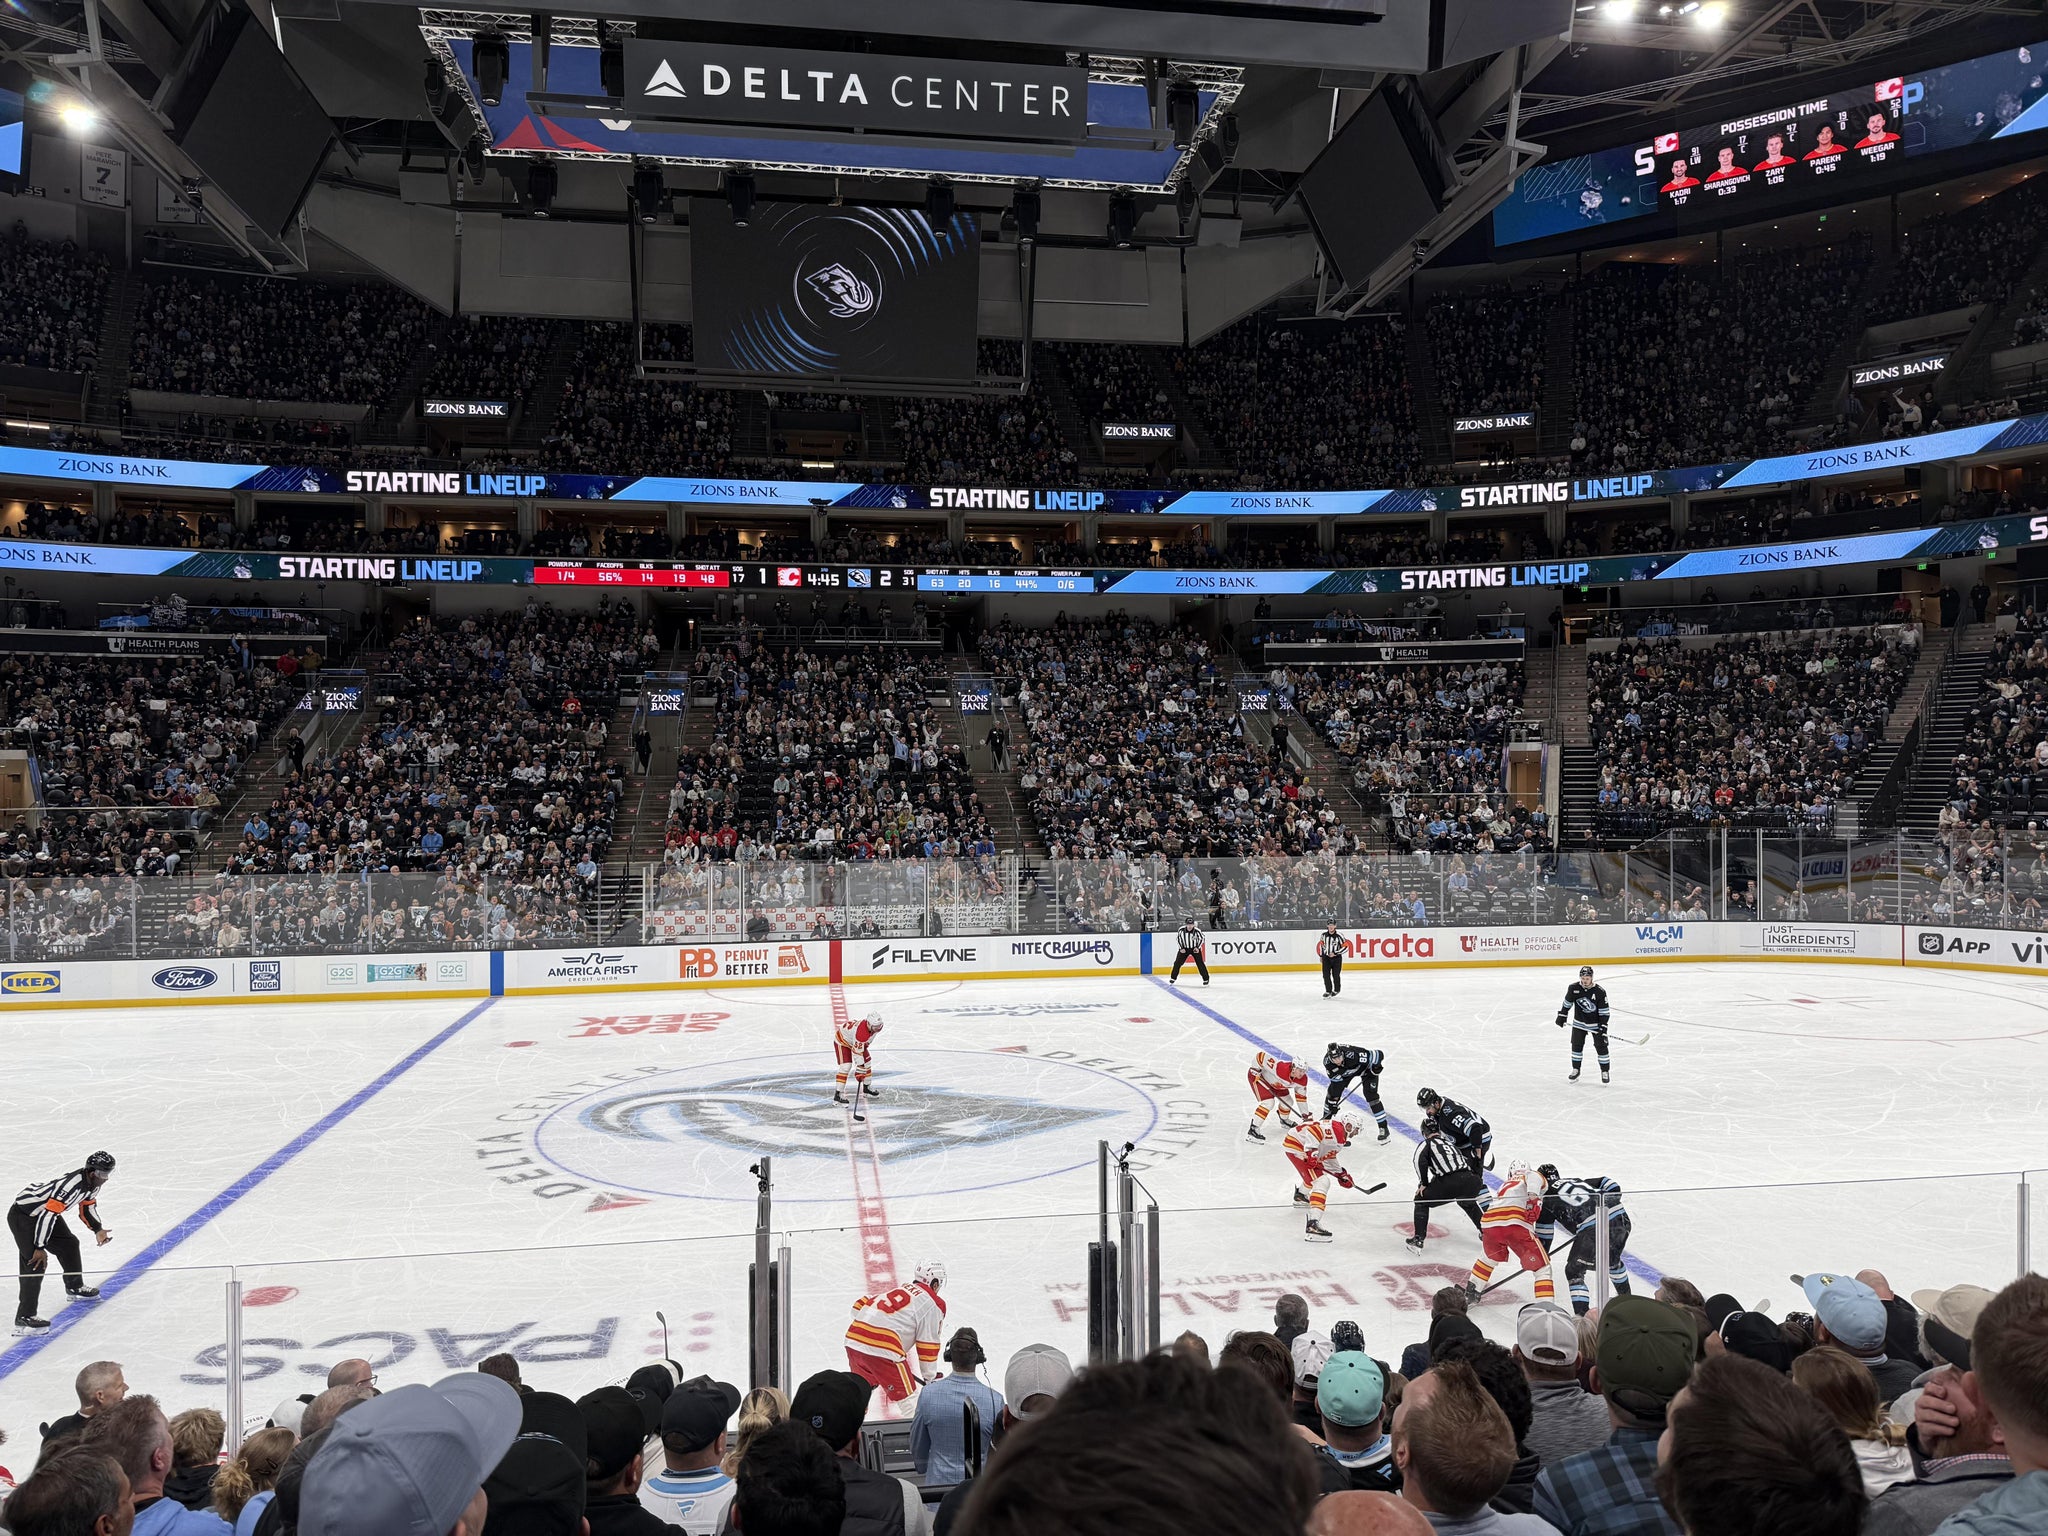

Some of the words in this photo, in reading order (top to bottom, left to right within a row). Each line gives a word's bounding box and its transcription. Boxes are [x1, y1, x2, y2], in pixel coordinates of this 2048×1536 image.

[703, 64, 868, 105] DELTA
[891, 75, 1070, 117] CENTER
[1890, 99, 1901, 108] 52
[1720, 108, 1796, 136] POSSESSION
[1798, 99, 1828, 117] TIME
[1838, 111, 1847, 121] 19
[1860, 142, 1895, 156] WEEGAR
[1810, 154, 1841, 167] PAREKH
[1870, 153, 1886, 162] 1:19
[1765, 166, 1786, 177] ZARY
[1816, 164, 1836, 175] 0:45
[96, 167, 111, 184] 7
[1767, 176, 1784, 186] 1:06
[1704, 174, 1751, 191] SHARANGOVICH
[1669, 188, 1691, 199] KADRI
[1718, 186, 1737, 196] 0:33
[1674, 196, 1688, 206] 1:17
[1856, 367, 1900, 384] ZIONS
[1903, 358, 1944, 376] BANK
[426, 402, 465, 414] ZIONS
[1456, 420, 1492, 431] ZIONS
[1104, 426, 1138, 437] ZIONS
[58, 458, 114, 474] ZIONS
[1807, 453, 1858, 471] ZIONS
[347, 470, 460, 494] STARTING
[466, 473, 546, 496] LINEUP
[690, 484, 737, 497] ZIONS
[1460, 482, 1568, 508] STARTING
[1574, 474, 1652, 500] LINEUP
[929, 488, 1030, 509] STARTING
[1034, 490, 1104, 511] LINEUP
[1230, 497, 1270, 508] ZIONS
[1739, 551, 1788, 566] ZIONS
[279, 556, 395, 579] STARTING
[402, 560, 482, 580] LINEUP
[557, 572, 576, 582] 1/4
[598, 572, 622, 582] 56%
[641, 574, 654, 582] 14
[674, 574, 686, 583] 19
[700, 574, 715, 584] 48
[732, 574, 744, 583] 17
[759, 568, 766, 584] 1
[808, 574, 840, 586] 4:45
[880, 570, 892, 586] 2
[902, 577, 914, 586] 31
[1400, 567, 1506, 590] STARTING
[1511, 563, 1589, 586] LINEUP
[931, 578, 944, 588] 63
[958, 578, 972, 588] 20
[989, 579, 1000, 588] 16
[1016, 580, 1038, 589] 44%
[1057, 580, 1074, 590] 0/6
[1176, 576, 1215, 588] ZIONS
[128, 639, 166, 649] HEALTH
[168, 640, 200, 649] PLANS
[1396, 649, 1428, 657] HEALTH
[326, 692, 358, 701] ZIONS
[651, 694, 681, 703] ZIONS
[961, 694, 988, 703] ZIONS
[1242, 694, 1268, 702] ZIONS
[326, 702, 359, 710] BANK
[651, 702, 681, 712] BANK
[961, 702, 989, 711] BANK
[1768, 926, 1793, 934] JUST
[1480, 938, 1519, 947] HEALTH
[1524, 936, 1558, 944] OFFICIAL
[1768, 935, 1850, 945] INGREDIENTS
[1211, 942, 1277, 954] TOYOTA
[725, 949, 769, 962] PEANUT
[892, 948, 976, 963] FILEVINE
[252, 963, 277, 972] BUILT
[680, 948, 718, 978] PB
[330, 968, 353, 976] G2G
[380, 966, 402, 976] G2G
[440, 965, 463, 974] G2G
[547, 966, 601, 977] AMERICA
[604, 965, 638, 975] FIRST
[686, 966, 698, 978] fit
[725, 963, 768, 976] BETTER
[7, 977, 55, 987] IKEA
[164, 969, 206, 987] Ford
[253, 981, 278, 989] TOUGH
[573, 1012, 732, 1028] GEEK
[568, 1022, 720, 1038] SEAT
[1359, 1051, 1368, 1063] 82
[1267, 1058, 1276, 1070] 47
[496, 1066, 671, 1122] CENTER
[1040, 1050, 1182, 1092] DELTA
[1128, 1100, 1208, 1171] CENTER
[1451, 1114, 1466, 1128] 22
[1324, 1128, 1334, 1140] 91
[476, 1131, 589, 1199] DELTA
[1176, 1268, 1332, 1286] UNIVERSITY
[1051, 1281, 1360, 1322] HEALH
[180, 1316, 620, 1385] PACS
